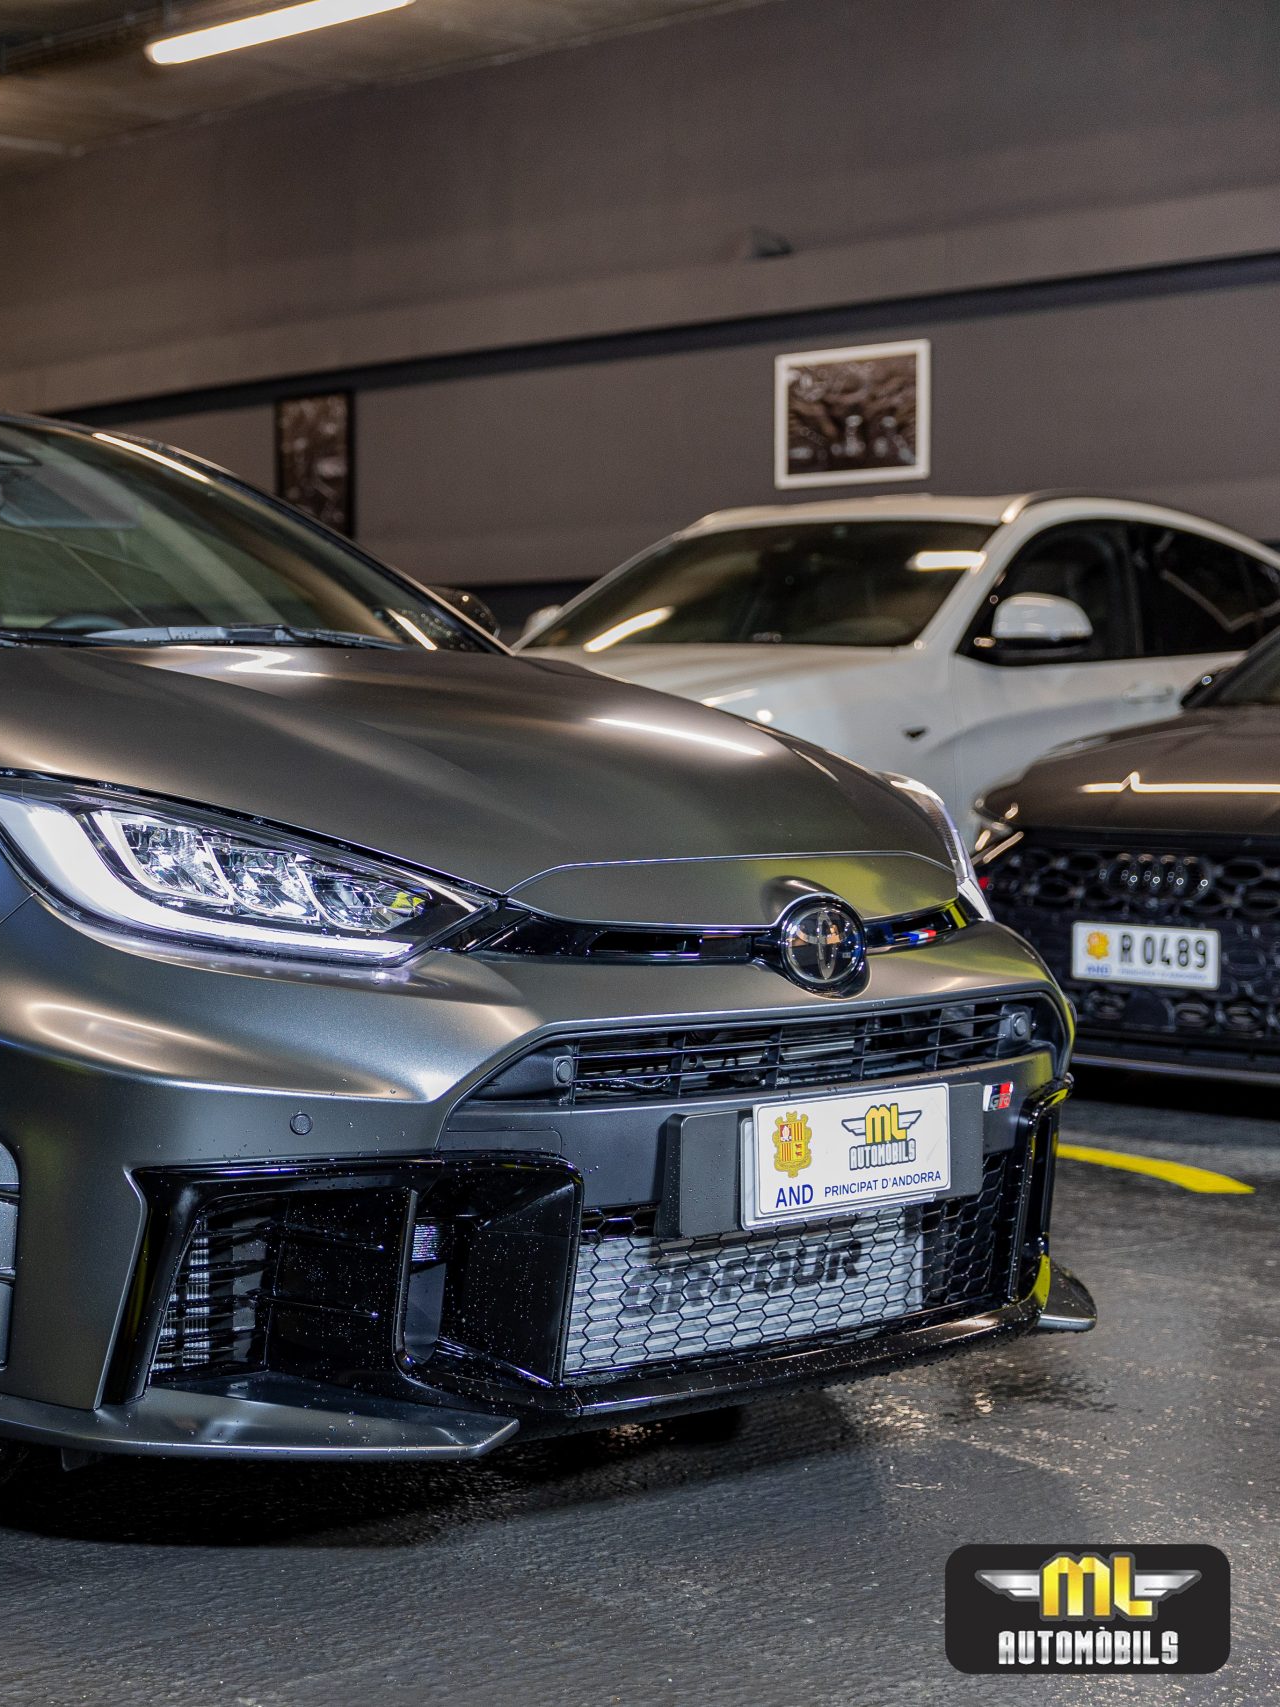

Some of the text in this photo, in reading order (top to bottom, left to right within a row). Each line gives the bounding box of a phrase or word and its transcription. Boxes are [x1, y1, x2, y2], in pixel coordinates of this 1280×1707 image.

[865, 1103, 908, 1145] ML
[775, 1183, 814, 1209] AND
[824, 1170, 942, 1198] PRINCIPAT D'ANDORRA
